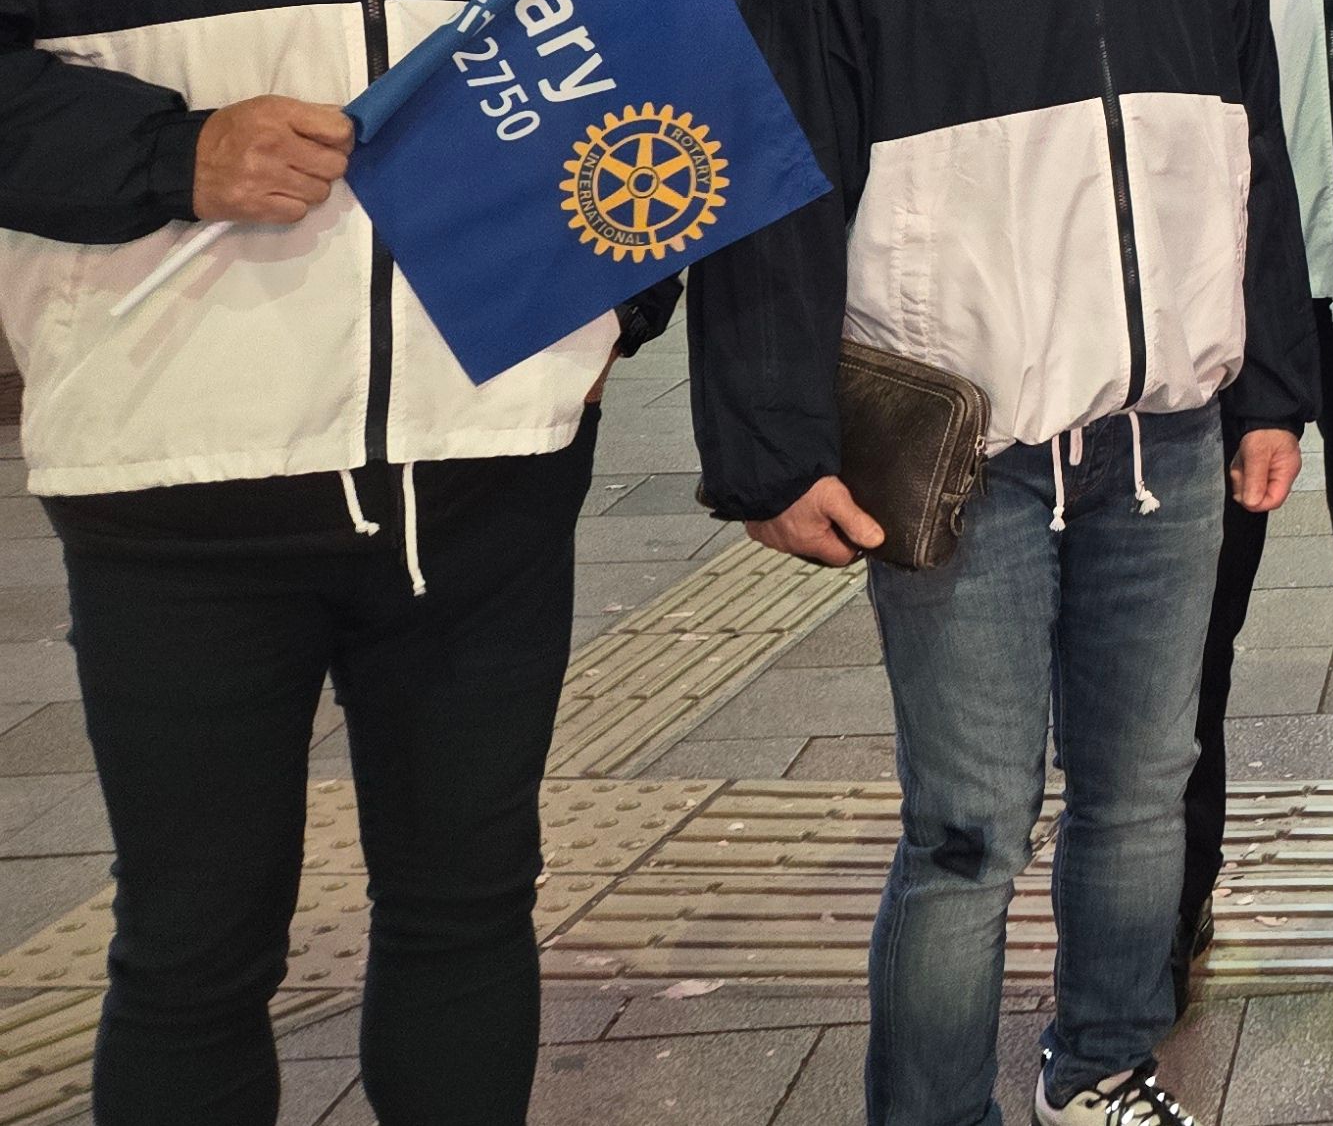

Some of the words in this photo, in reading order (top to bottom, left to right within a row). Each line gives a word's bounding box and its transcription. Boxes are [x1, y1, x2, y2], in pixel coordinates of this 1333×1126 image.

[452, 37, 540, 141] 2750
[578, 152, 645, 245] INTERNATIONAL
[671, 128, 711, 184] ROTARY
